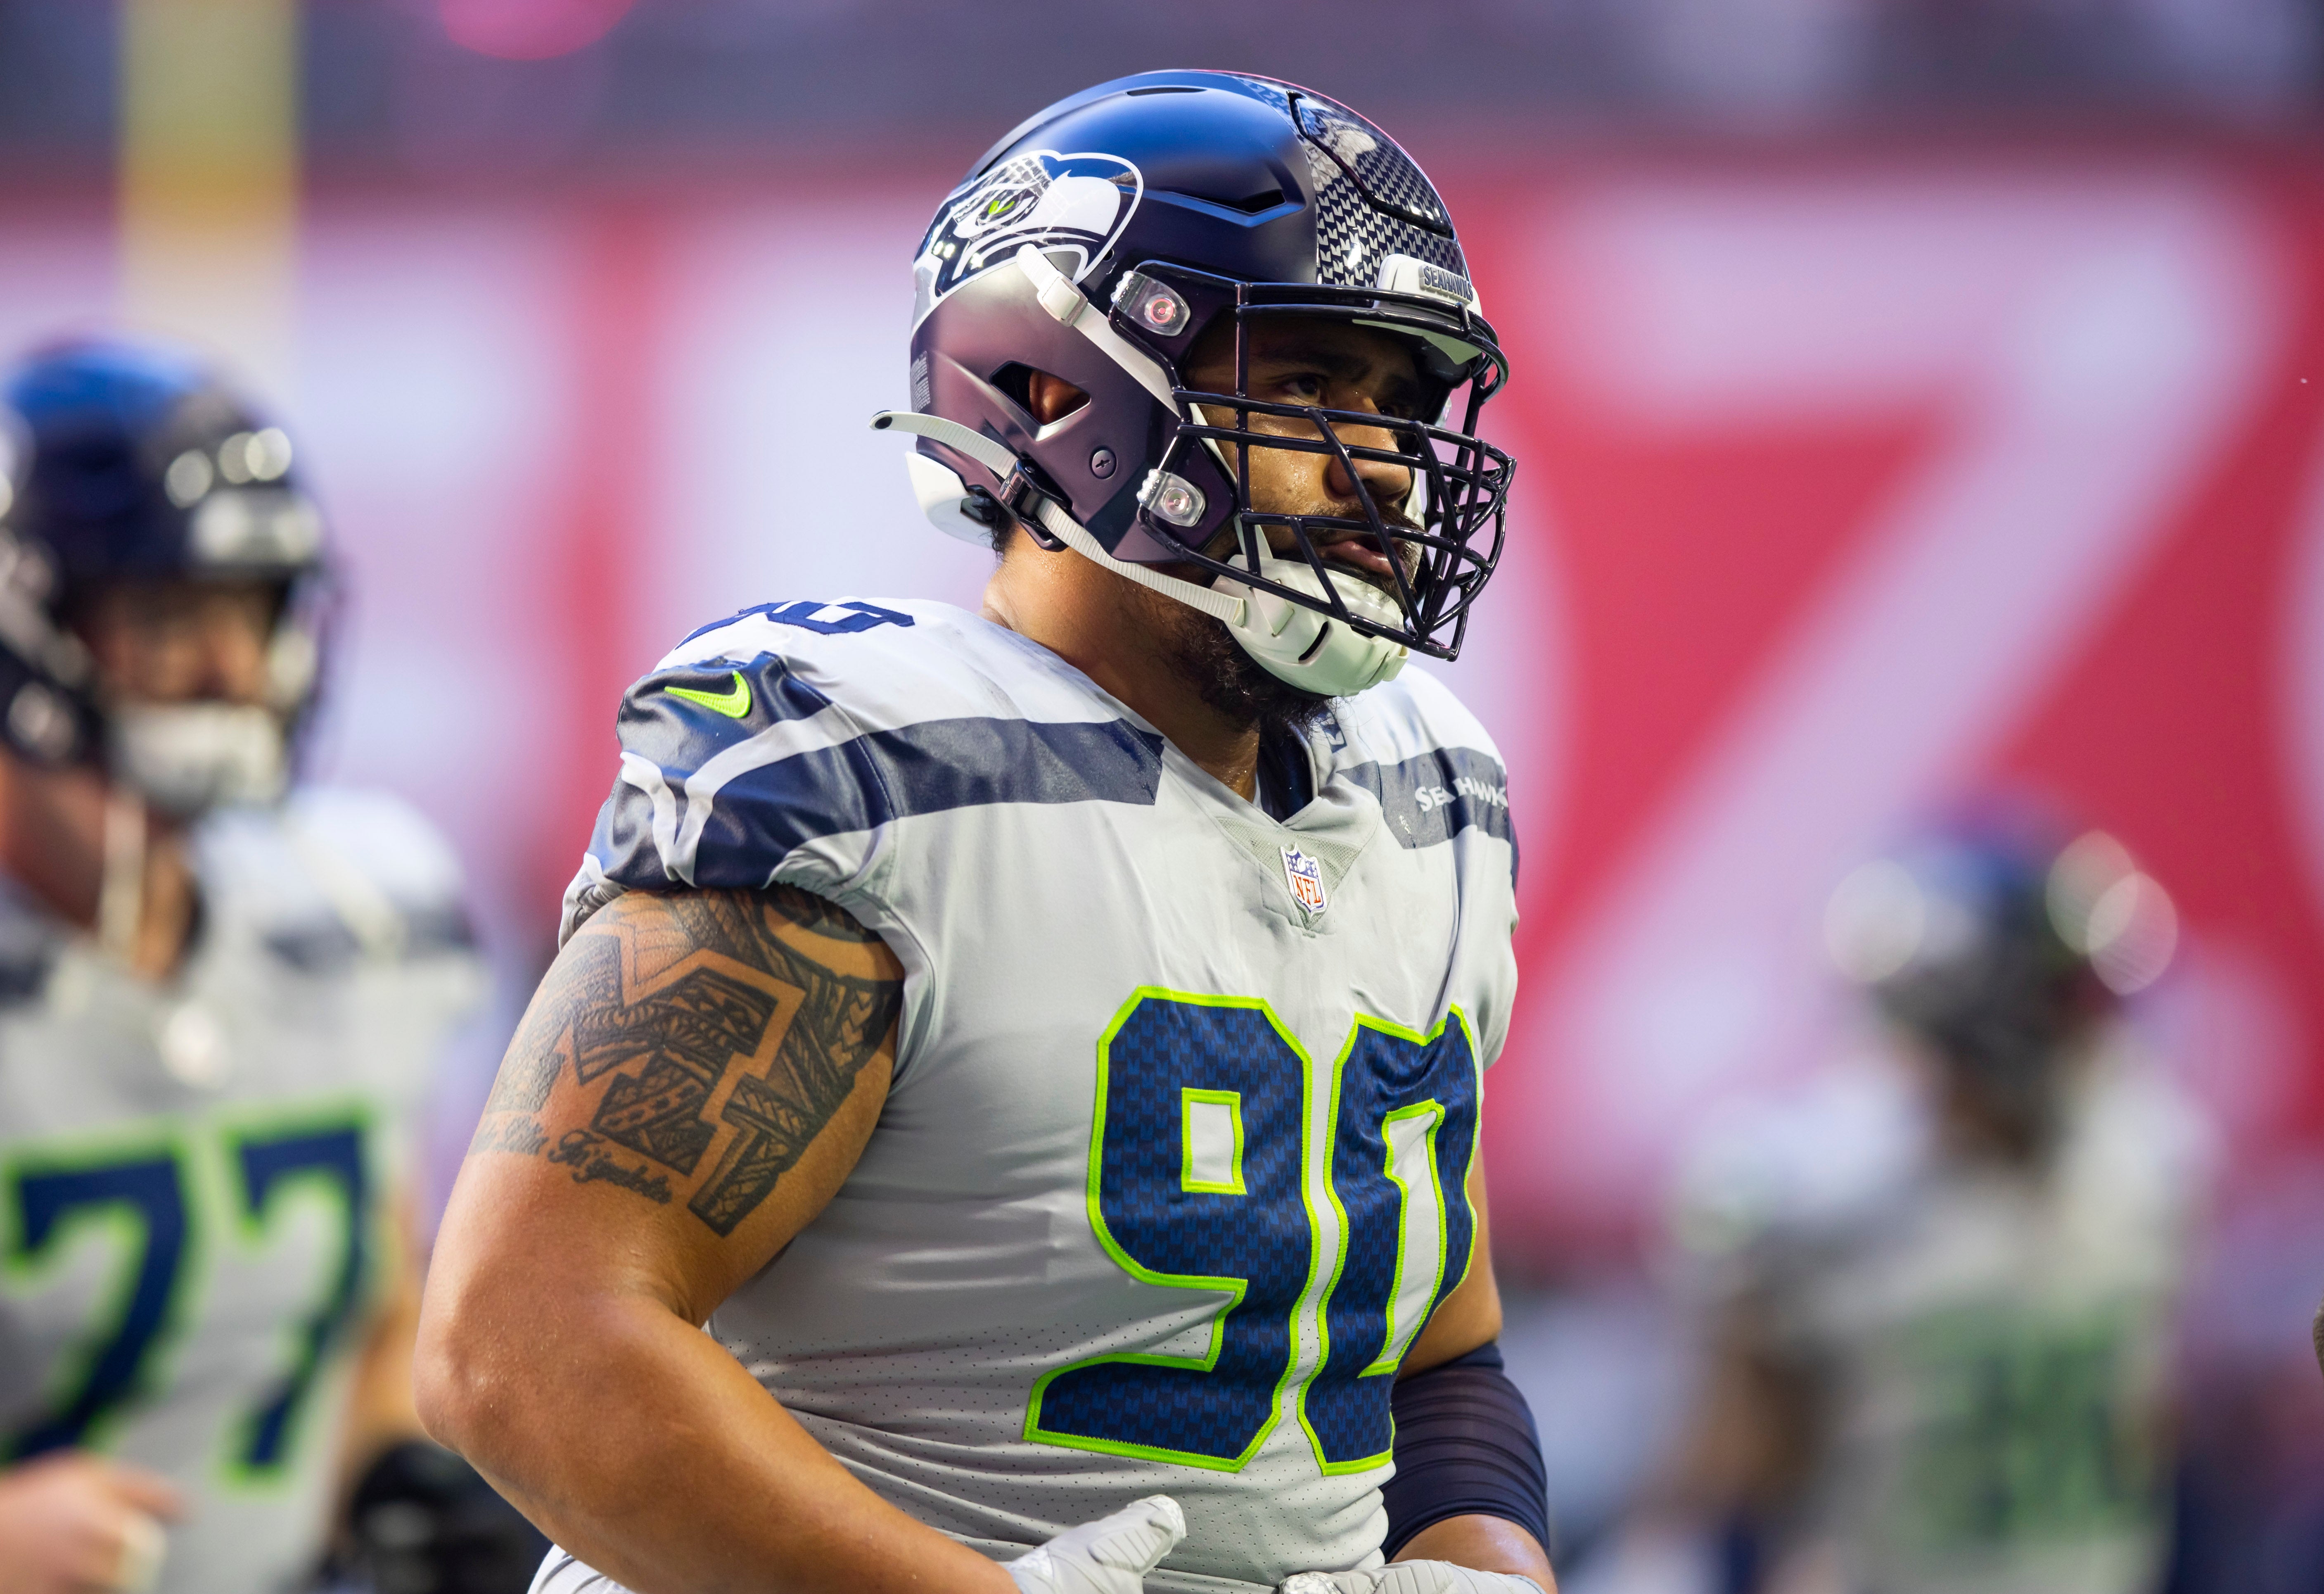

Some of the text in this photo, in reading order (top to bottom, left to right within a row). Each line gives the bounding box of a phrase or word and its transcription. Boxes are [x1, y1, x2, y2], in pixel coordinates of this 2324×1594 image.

[1424, 266, 1474, 302] SEAHAWKS
[1293, 874, 1321, 906] NFL
[0, 1105, 378, 1489] 77
[1023, 985, 1477, 1476] 90
